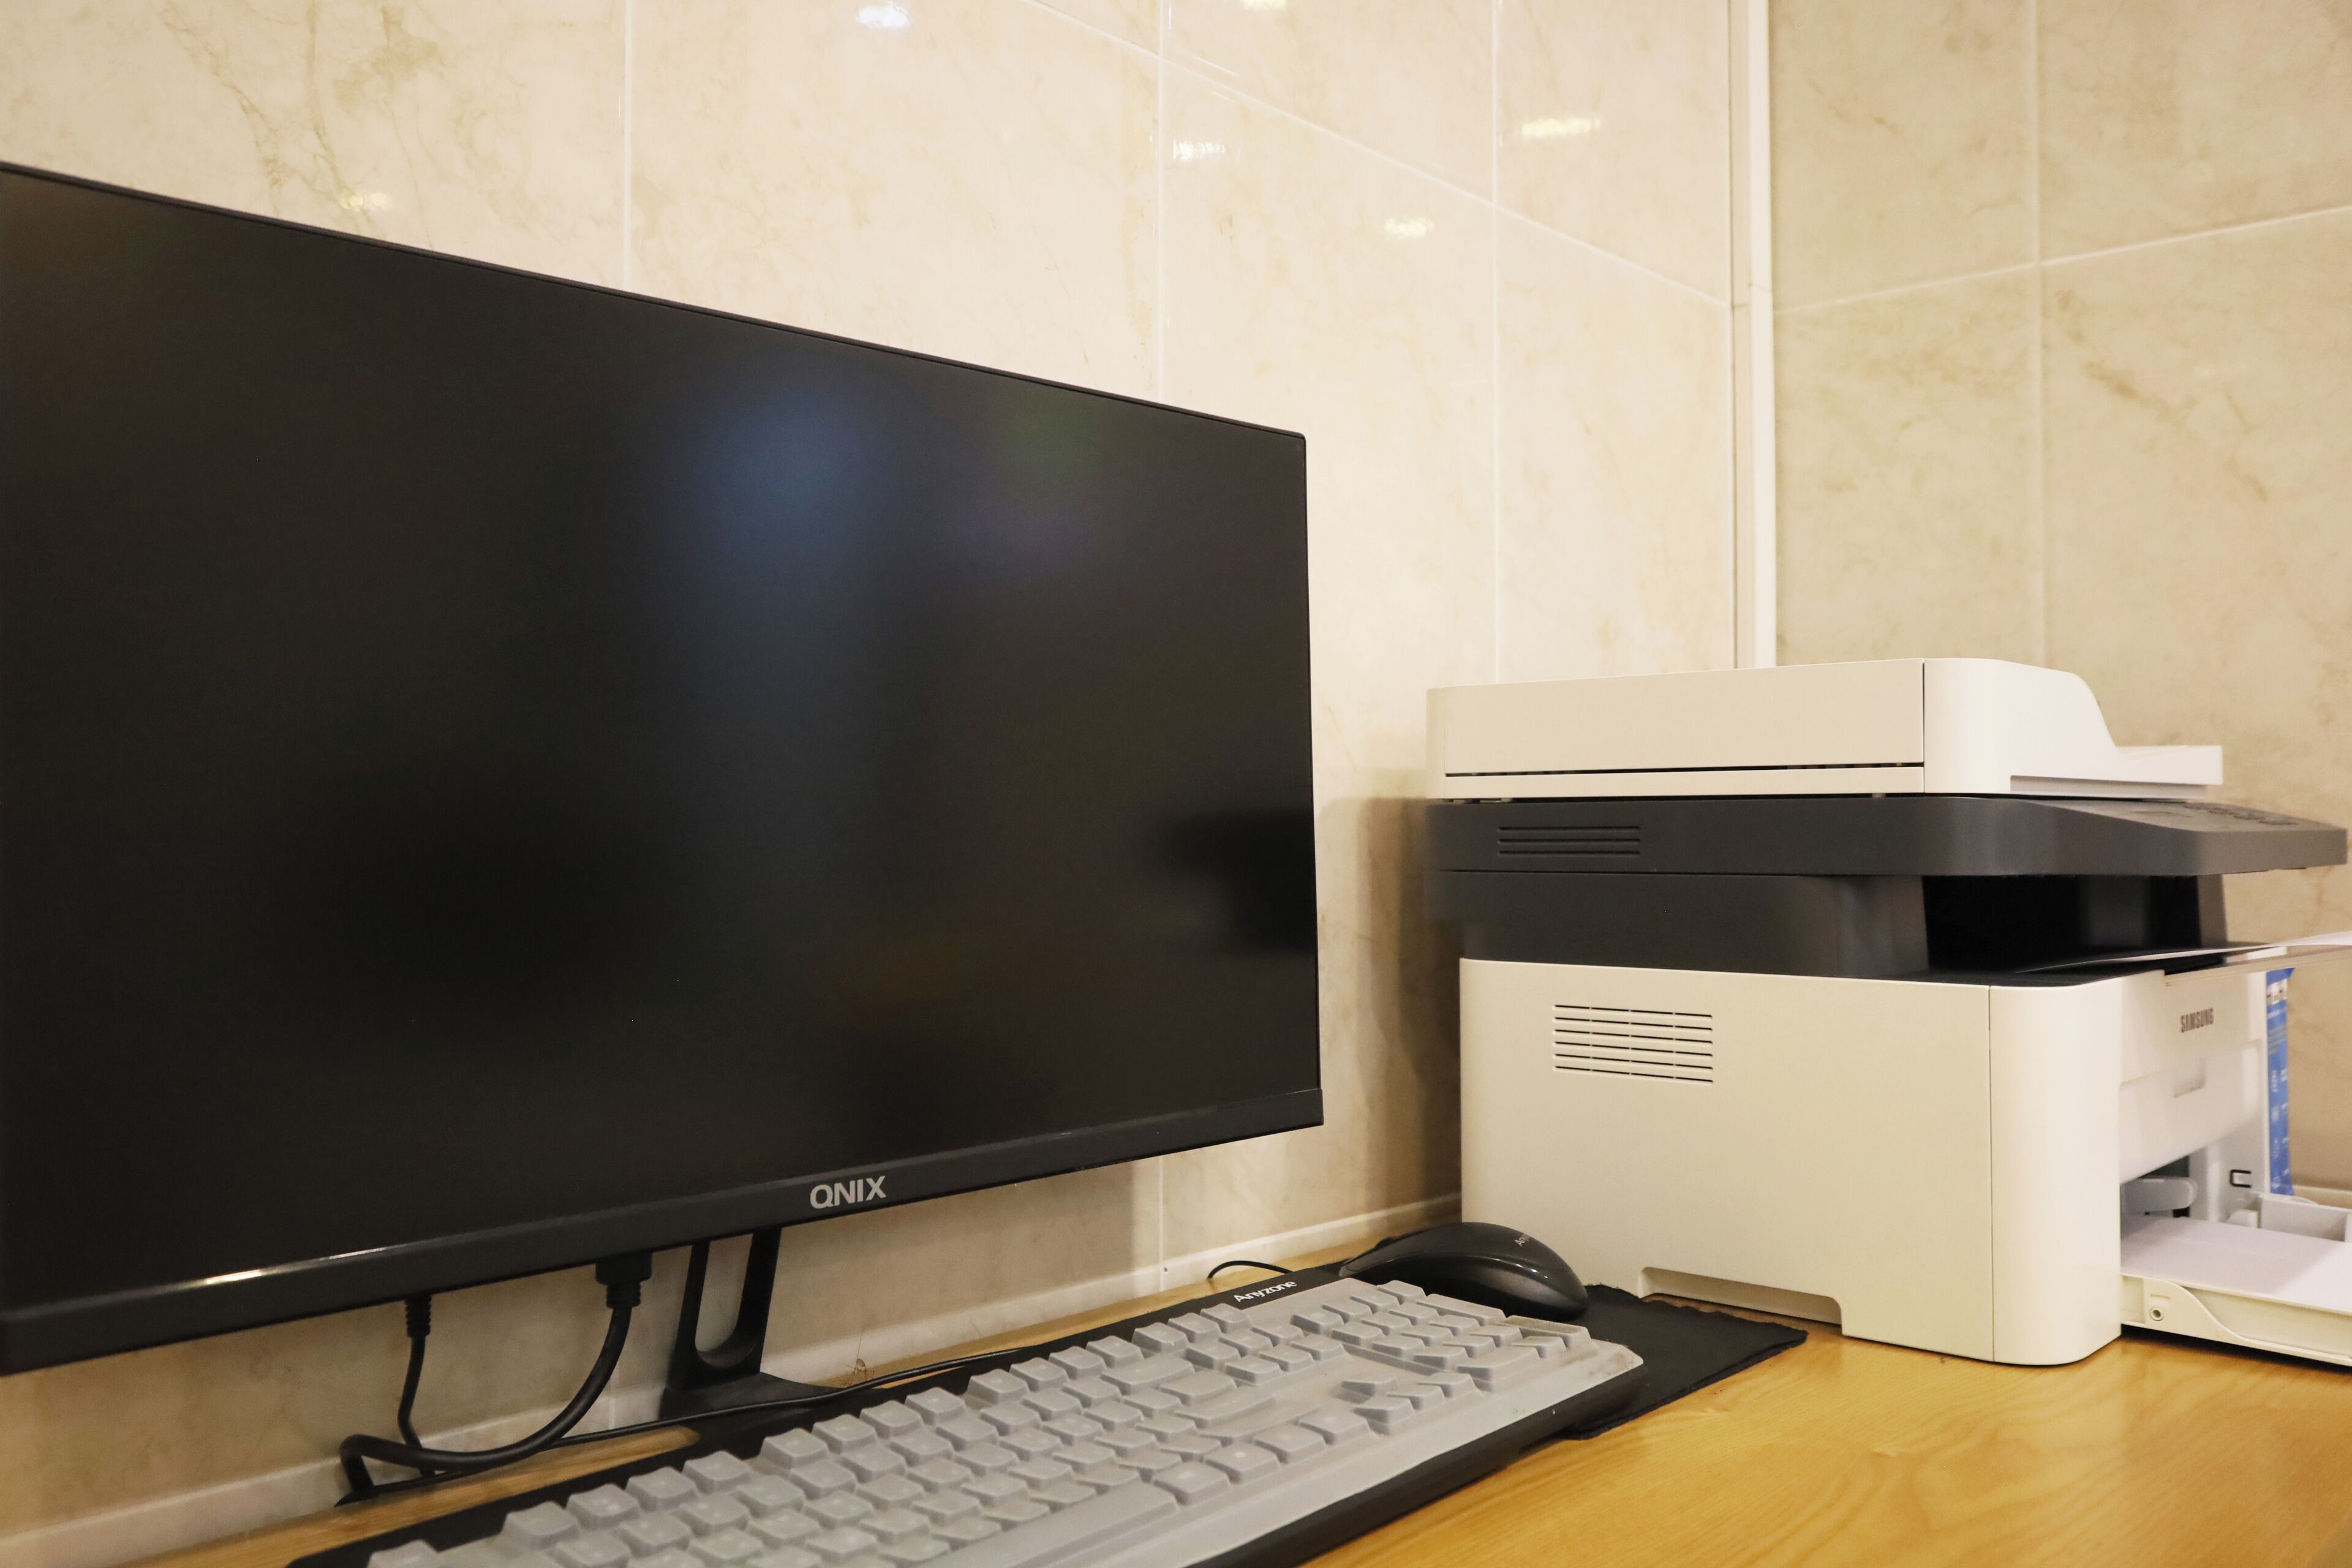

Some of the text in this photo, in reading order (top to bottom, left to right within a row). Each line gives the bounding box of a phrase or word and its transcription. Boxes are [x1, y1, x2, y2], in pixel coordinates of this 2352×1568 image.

[2181, 1008, 2214, 1033] SAMSUNG
[810, 1175, 886, 1209] QNIX
[1234, 1281, 1297, 1302] Anyzone
